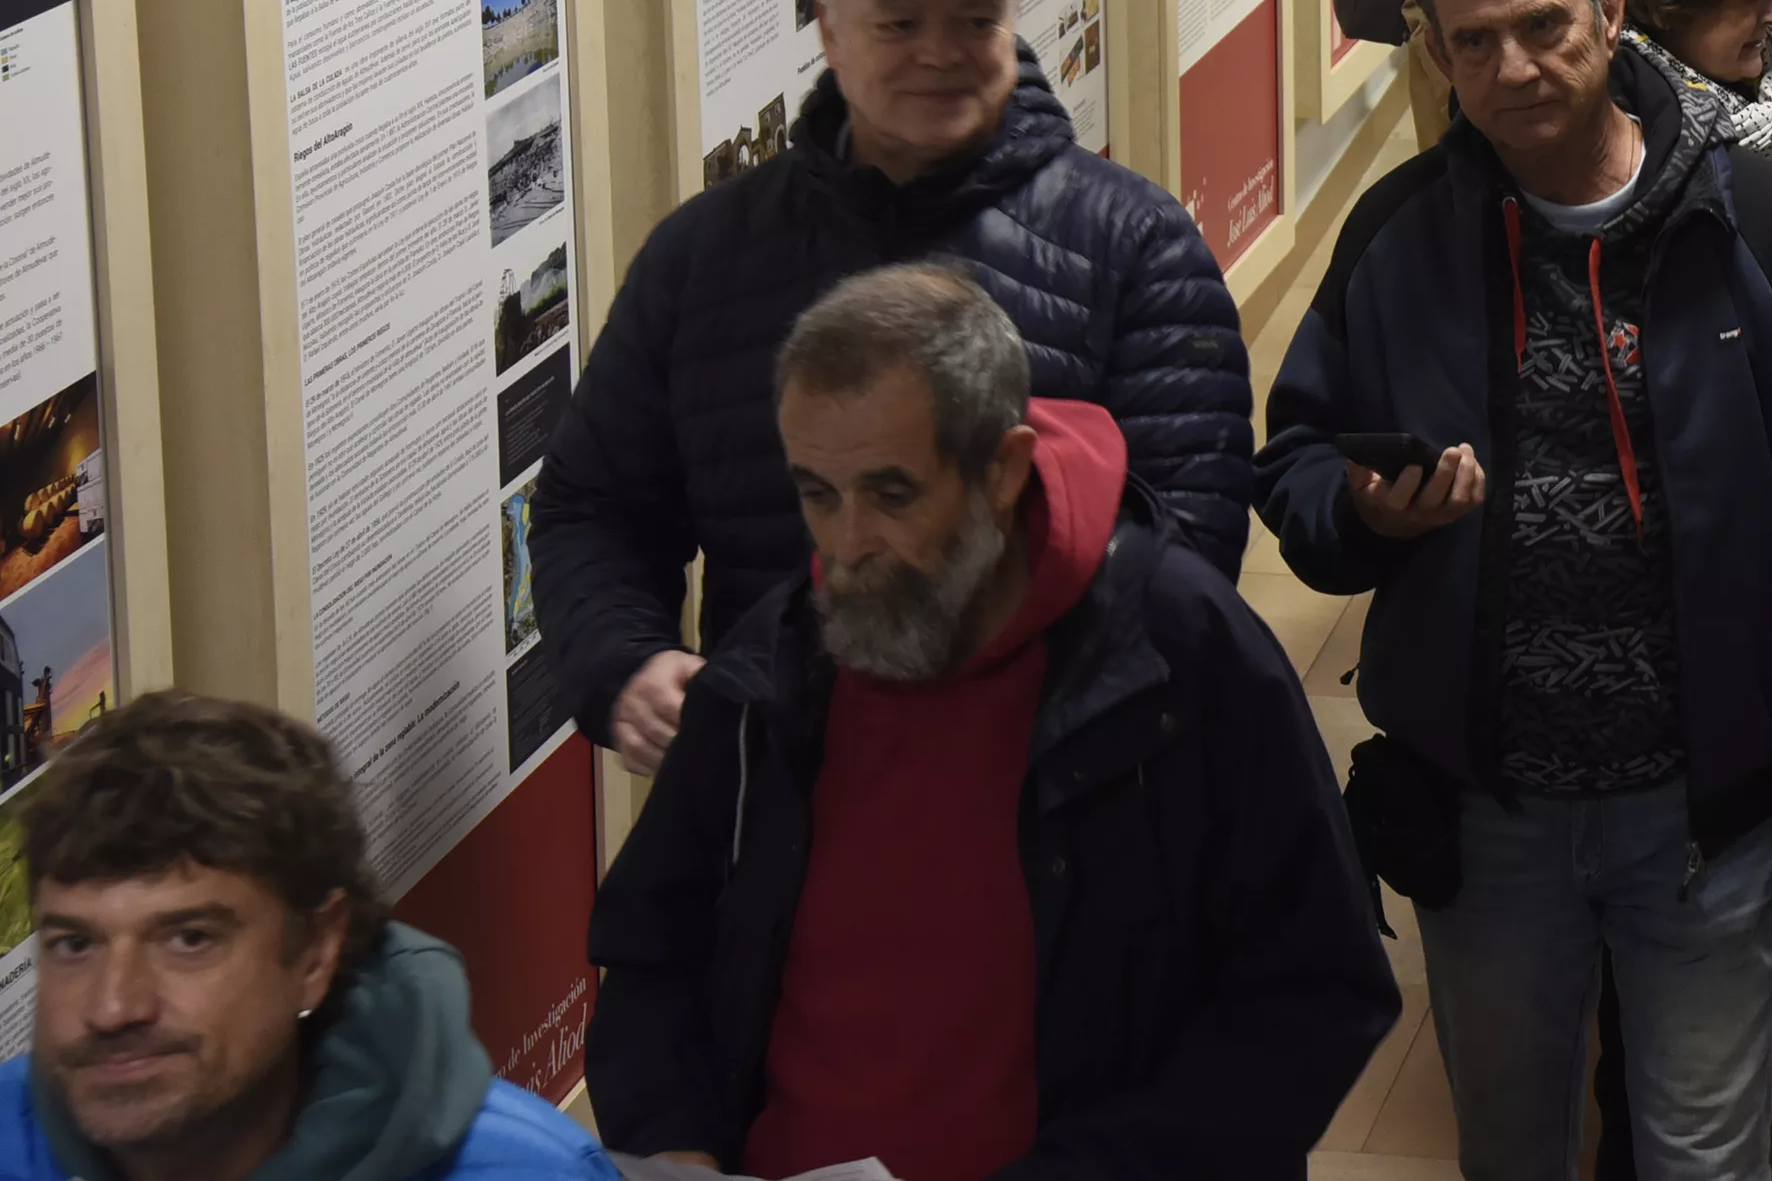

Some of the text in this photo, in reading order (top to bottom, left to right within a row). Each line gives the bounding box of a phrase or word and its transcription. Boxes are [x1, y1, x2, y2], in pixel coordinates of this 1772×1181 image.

[293, 143, 312, 165] Riegos
[313, 137, 322, 152] del
[508, 977, 587, 1071] de Investigación
[543, 1002, 588, 1088] Aliod
